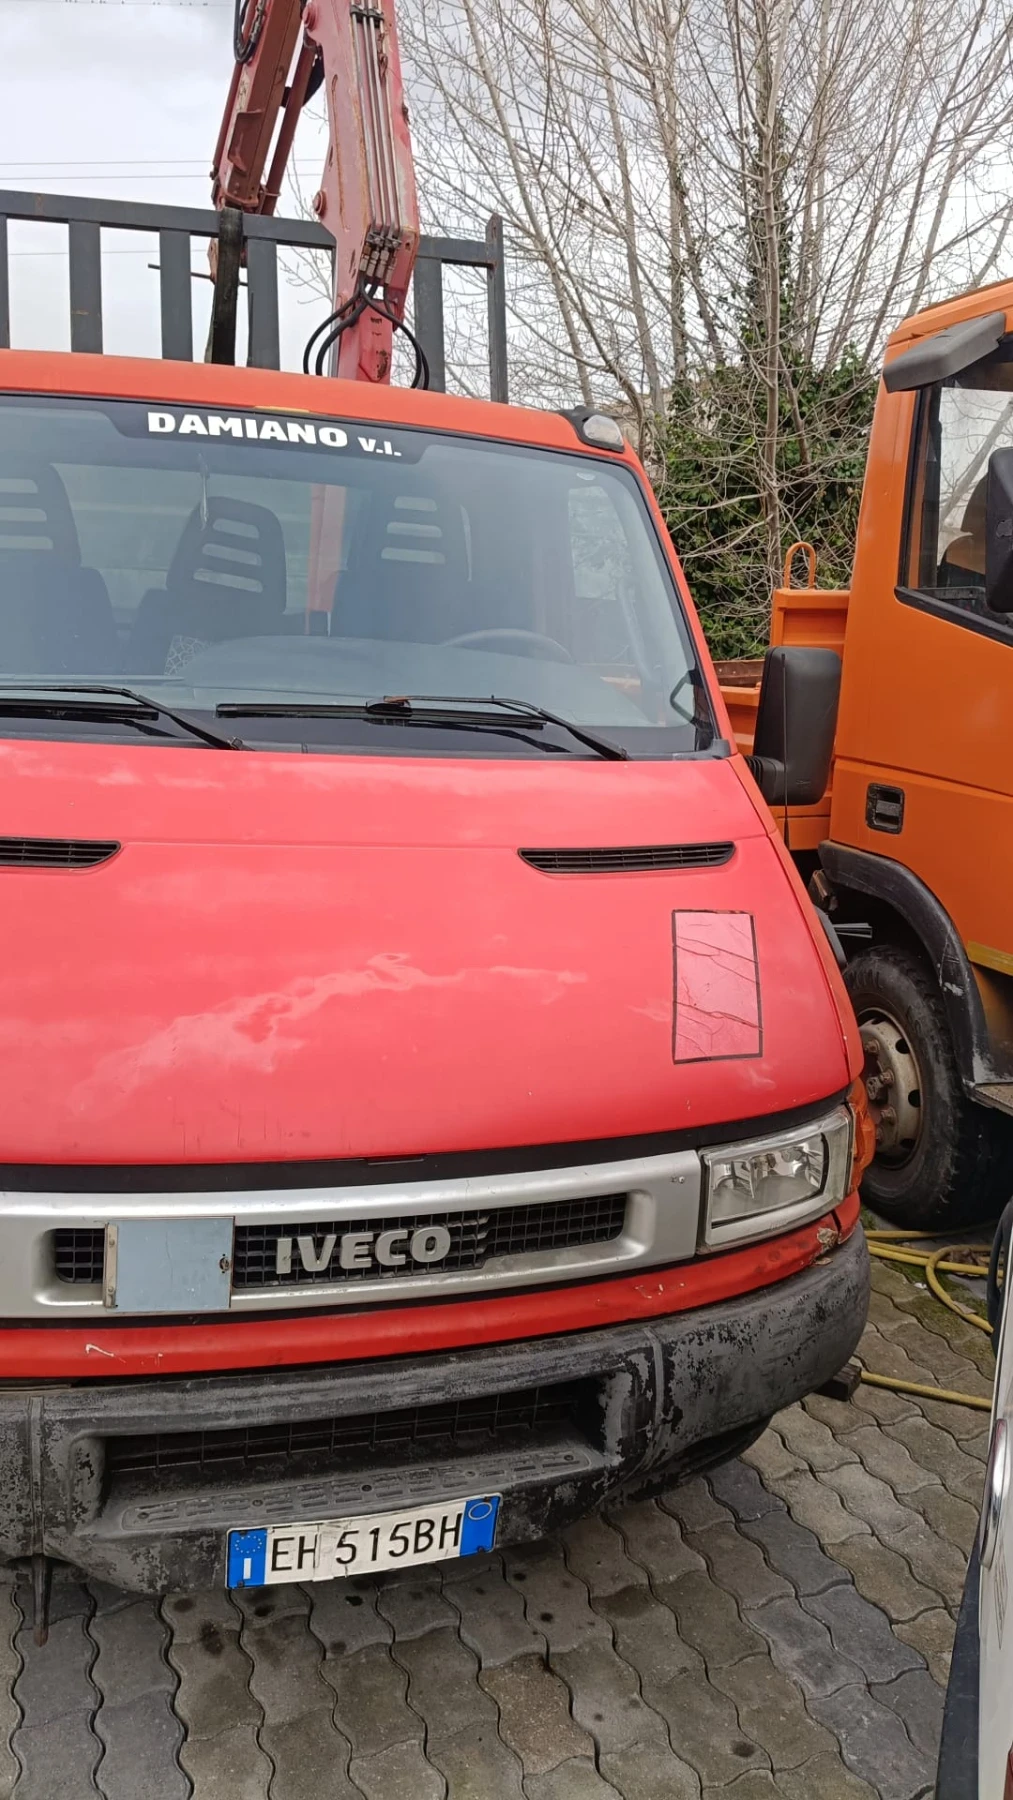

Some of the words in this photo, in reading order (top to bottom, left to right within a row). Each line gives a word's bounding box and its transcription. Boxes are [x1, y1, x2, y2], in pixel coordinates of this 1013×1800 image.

[147, 411, 348, 448] DAMIANO
[276, 1226, 451, 1275] IVECO
[270, 1535, 318, 1572] EH
[335, 1512, 463, 1565] 515BH
